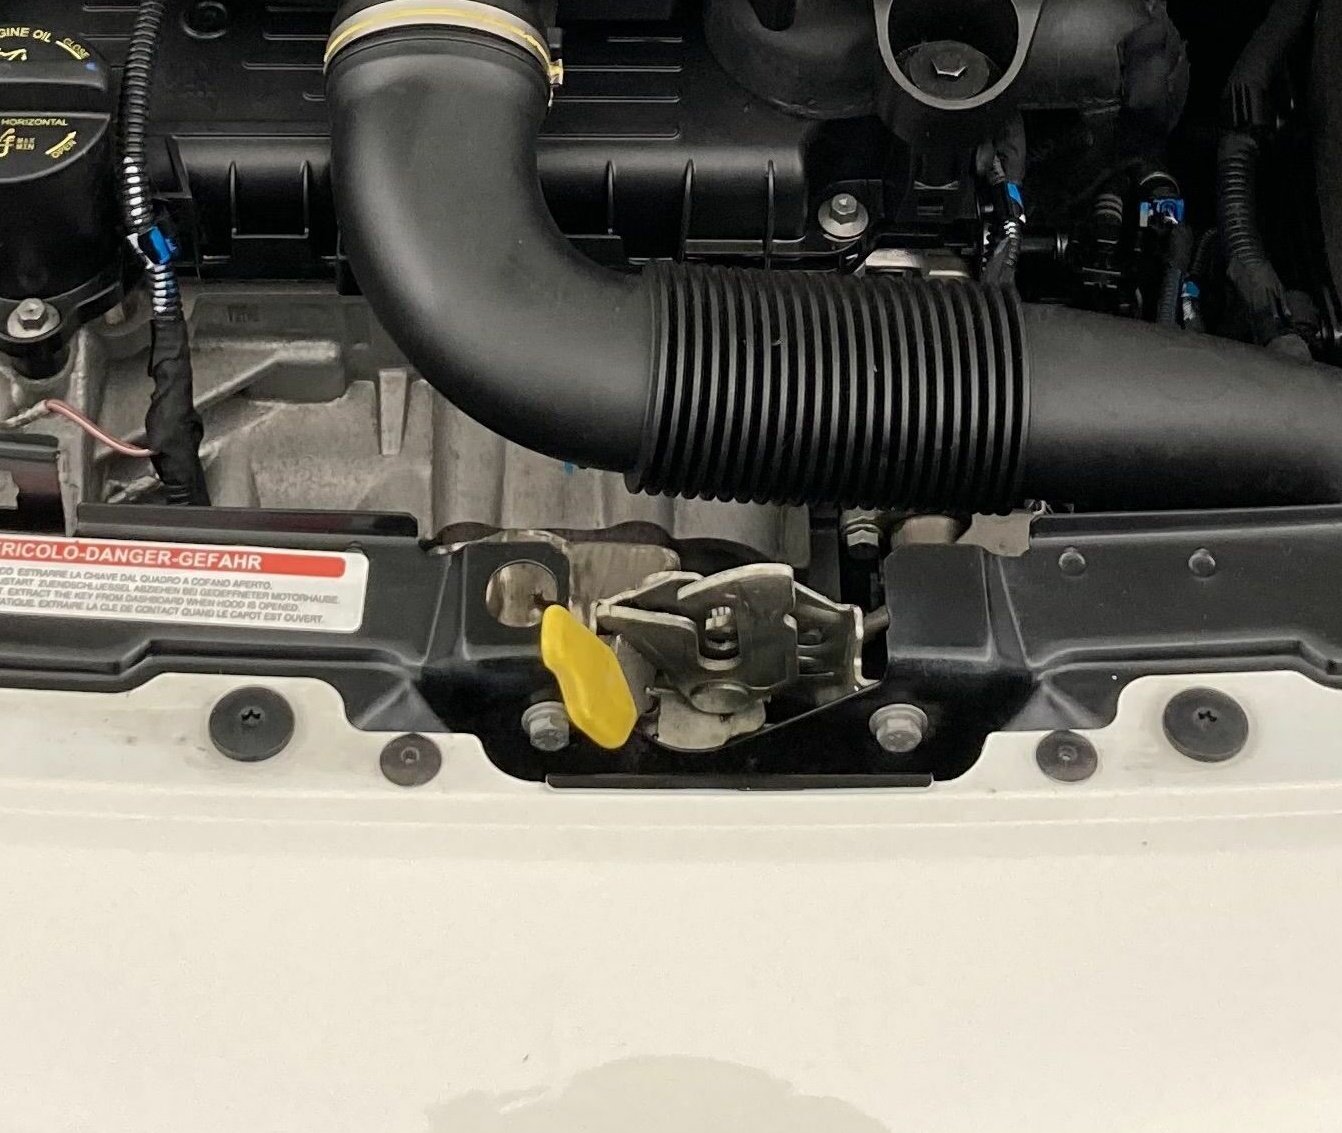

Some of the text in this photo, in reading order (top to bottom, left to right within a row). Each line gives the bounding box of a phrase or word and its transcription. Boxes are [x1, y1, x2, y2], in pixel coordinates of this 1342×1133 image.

[32, 29, 53, 44] OIL
[62, 36, 91, 60] CLOSE
[1, 118, 69, 127] HORIZONTAL
[51, 139, 77, 159] OPEN
[17, 567, 68, 578] ESTRARRE
[70, 571, 81, 579] LA
[81, 571, 119, 582] CHIAVE
[120, 573, 138, 583] DAL
[140, 574, 182, 585] QUADRO
[182, 577, 190, 585] A
[191, 577, 231, 588] COFANO
[232, 579, 273, 590] APERTO.
[7, 587, 52, 598] EXTRACT
[53, 590, 72, 599] THE
[74, 591, 94, 601] KEY
[95, 592, 124, 603] FROM
[125, 594, 185, 605] DASHBOARD
[186, 597, 215, 607] WHEN
[217, 599, 245, 608] HOOD
[246, 601, 257, 609] IS
[38, 599, 83, 610] EXTRAIRE
[85, 602, 98, 611] LA
[99, 603, 118, 612] CLE
[120, 604, 134, 613] DE
[135, 605, 179, 616] CONTACT
[181, 608, 215, 618] QUAND
[217, 610, 228, 618] LE
[230, 610, 262, 620] CAPOT
[264, 612, 283, 621] EST
